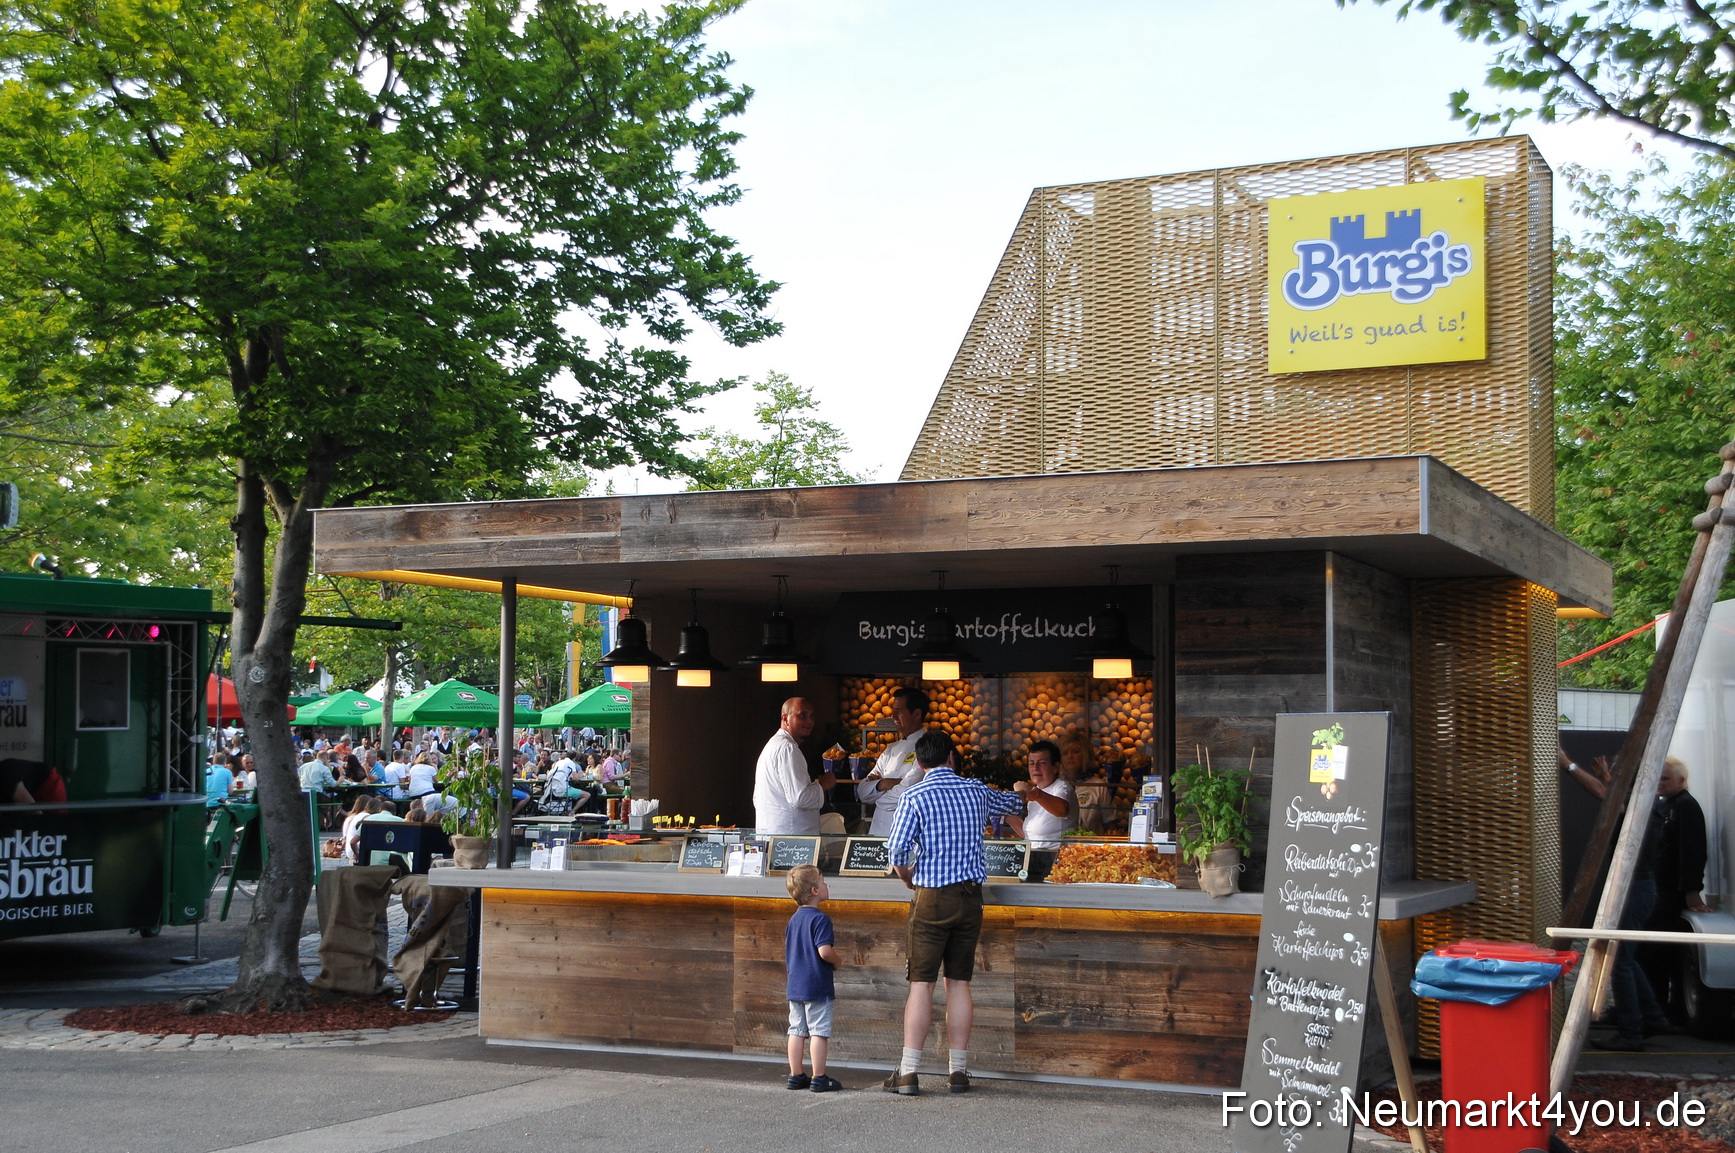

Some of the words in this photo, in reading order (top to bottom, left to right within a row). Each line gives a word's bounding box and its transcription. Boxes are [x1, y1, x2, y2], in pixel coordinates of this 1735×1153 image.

[1285, 233, 1469, 307] Burgis
[1290, 323, 1353, 345] Weil's
[1365, 315, 1426, 344] guad
[1438, 311, 1466, 332] is!
[859, 620, 925, 646] Burgis
[955, 612, 1096, 644] artoffelkuch
[0, 679, 14, 697] er
[1285, 795, 1366, 834] Speisenangebot:
[0, 829, 67, 859] rkter
[1284, 843, 1348, 873] Reiberdatschi
[1347, 857, 1362, 878] Dip
[1279, 879, 1348, 905] Schupfnudeln
[64, 903, 94, 916] BIER
[1286, 901, 1299, 912] mit
[1302, 901, 1352, 919] Sauerkraut
[1271, 933, 1344, 961] Kartoffelchips
[1265, 969, 1346, 1003] Kartoffelknödel
[1266, 995, 1278, 1005] mit
[1279, 995, 1330, 1020] Bratensoße
[1307, 1022, 1334, 1036] GROSS:
[1262, 1037, 1342, 1076] Semmelknödel
[1268, 1067, 1281, 1078] mit
